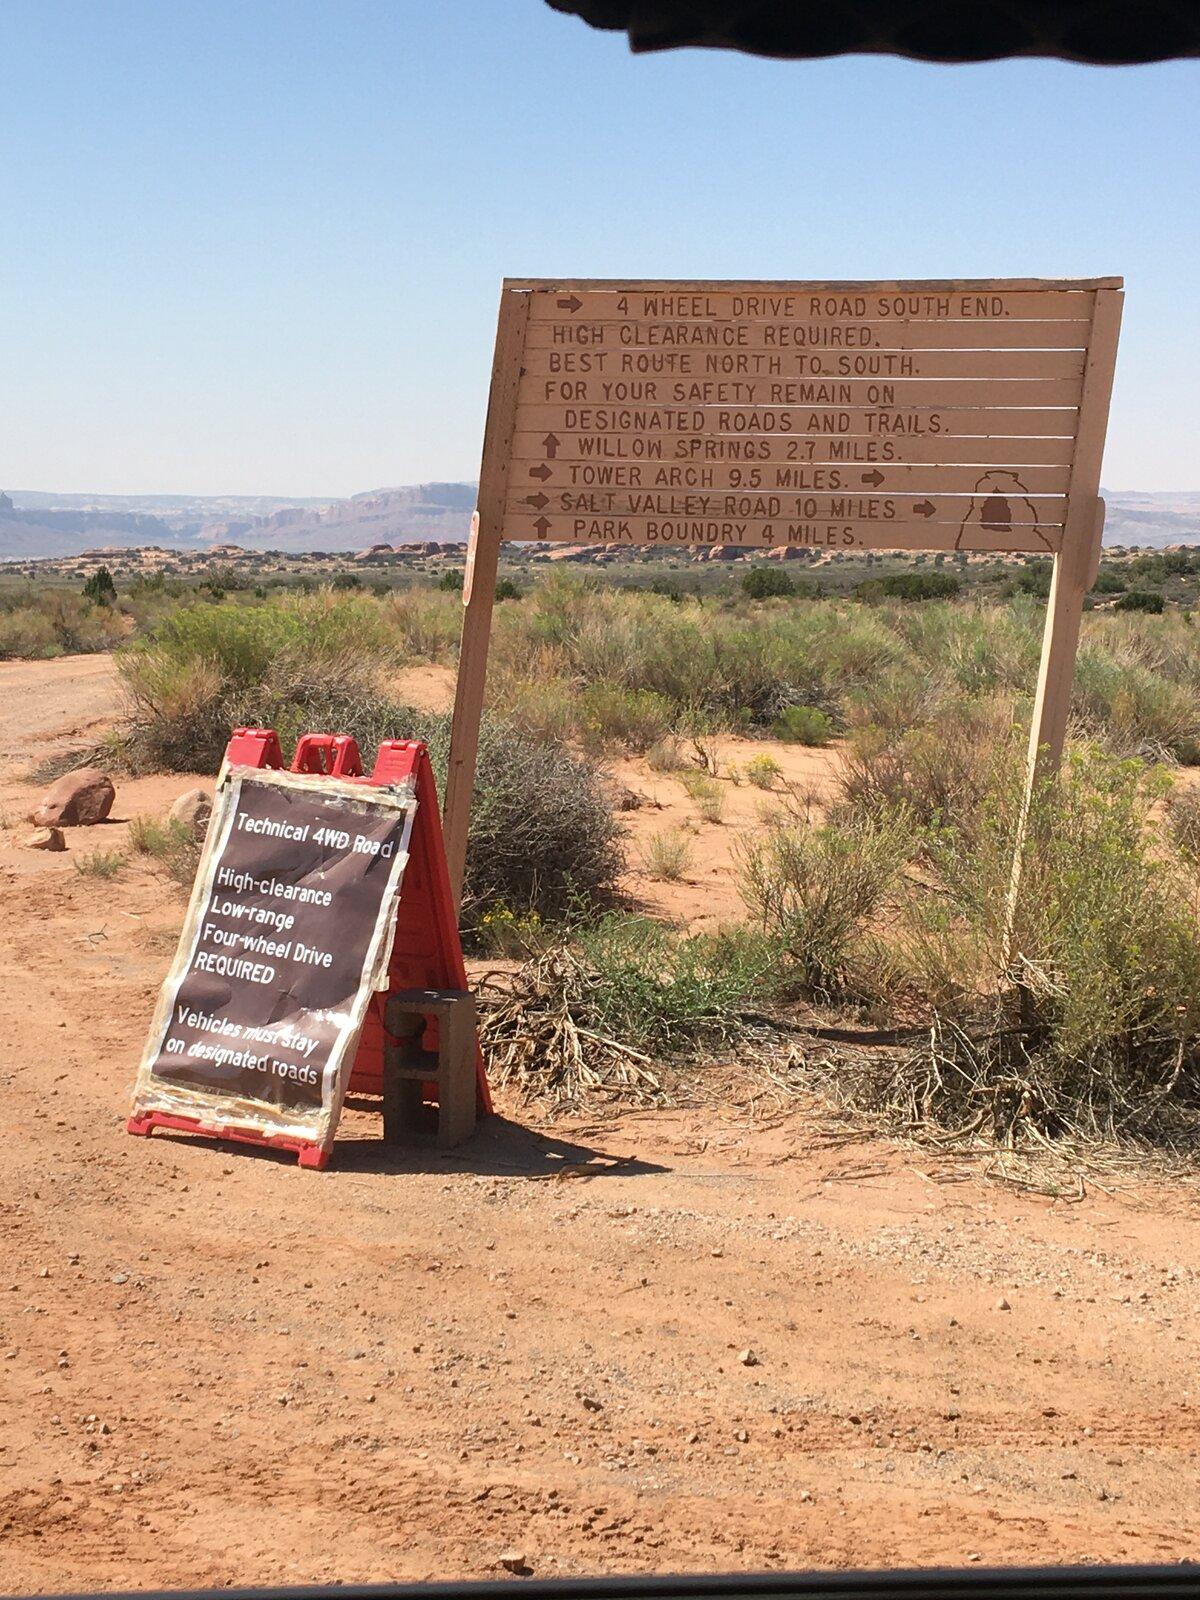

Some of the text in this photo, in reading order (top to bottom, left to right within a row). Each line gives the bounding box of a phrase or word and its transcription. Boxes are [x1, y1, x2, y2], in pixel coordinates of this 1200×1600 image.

[617, 296, 1010, 317] 4 WHEEL DRIVE ROAD SOUTH END.
[552, 325, 880, 347] HIGH CLEARANCE REQUIRED.
[550, 353, 608, 372] BEST
[622, 354, 692, 373] ROUTE
[706, 354, 781, 375] NORTH
[838, 355, 921, 375] SOUTH.
[545, 381, 895, 404] FOR YOUR SAFETY REMAIN ON
[565, 409, 950, 433] DESIGNATED ROADS AND TRAILS.
[578, 437, 903, 461] WILLOW SPRINGS 2.7 MILES.
[569, 465, 849, 490] TOWER ARCH 9.5 MILES.
[560, 492, 896, 519] SALT VALLEY ROAD 10 MILES
[573, 519, 864, 546] PARK BOUNDRY 4 MILES.
[237, 812, 394, 858] Technical 4WD Road
[218, 867, 332, 906] High-clearance
[210, 897, 295, 932] Low-range
[203, 923, 333, 968] Four-wheel Drive
[195, 951, 275, 985] REQUIRED
[178, 1005, 320, 1058] Vehicles must stay
[166, 1037, 318, 1085] on designated roads
